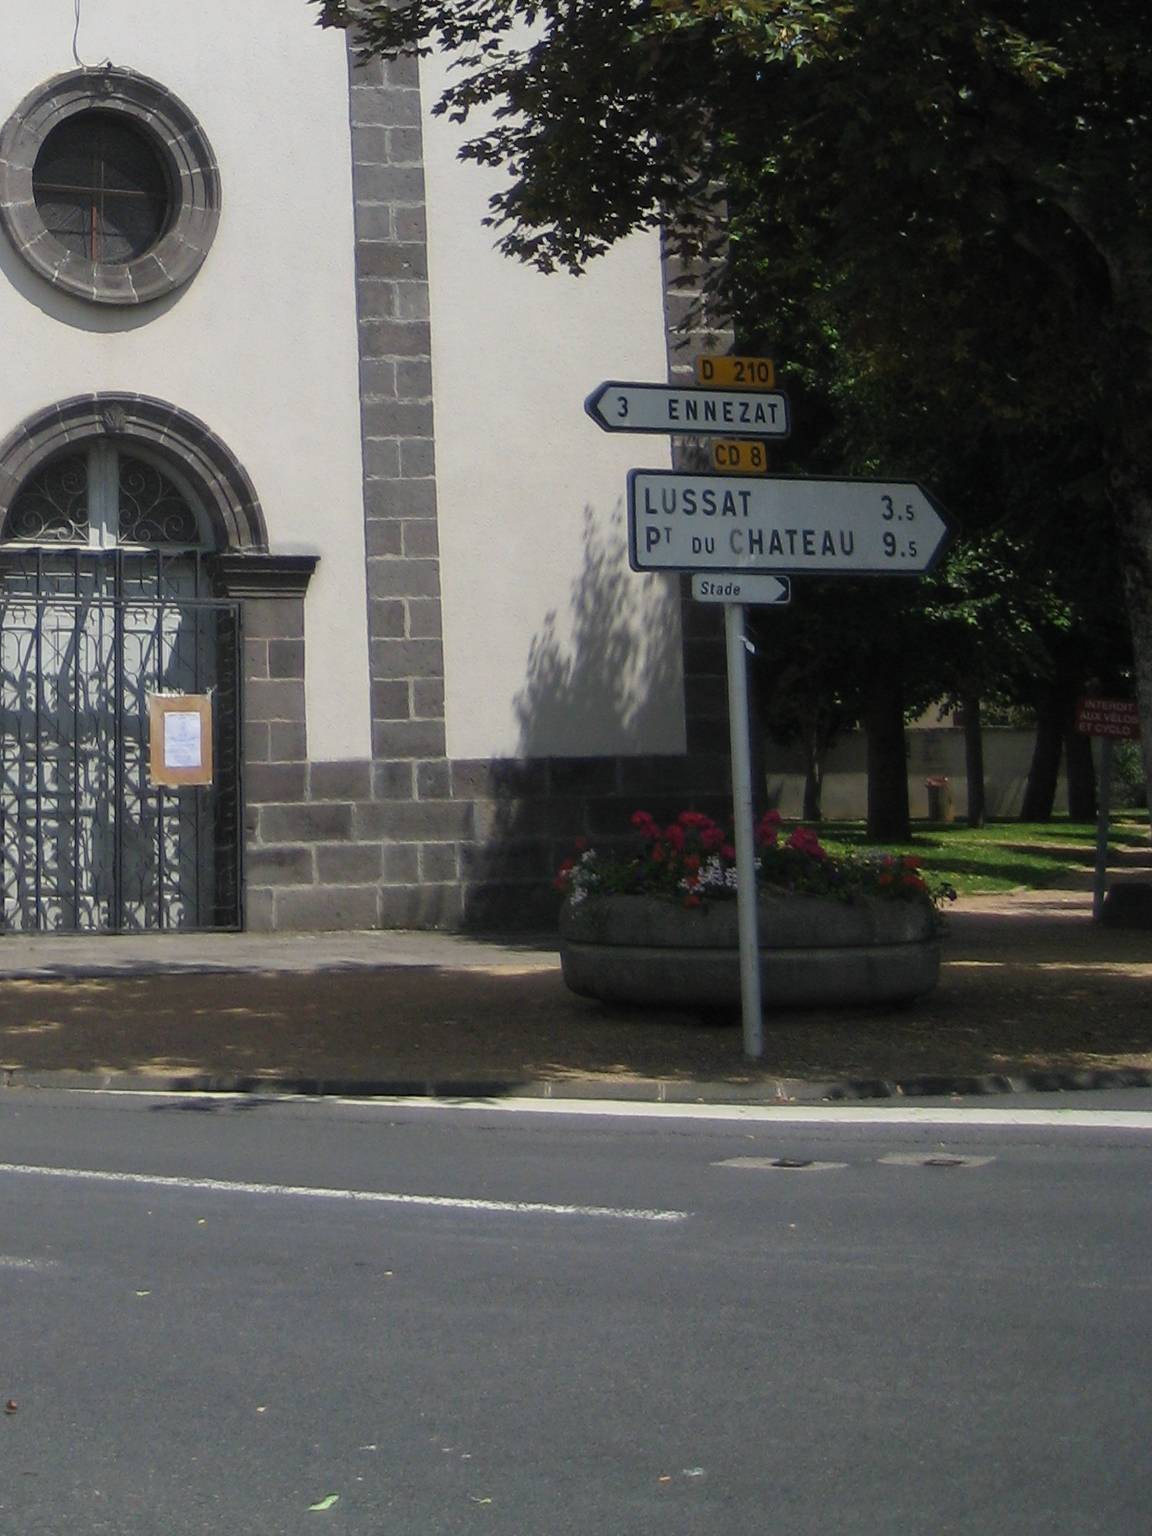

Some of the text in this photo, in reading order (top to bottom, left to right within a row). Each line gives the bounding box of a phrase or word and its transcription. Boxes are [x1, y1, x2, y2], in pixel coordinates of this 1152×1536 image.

[701, 359, 770, 383] D 210
[616, 396, 778, 424] 3 ENNEZAT
[714, 443, 762, 468] CD 8
[644, 487, 915, 521] LUSSAT 3.5
[691, 536, 715, 555] DU
[729, 528, 855, 557] CHATEAU
[882, 531, 918, 558] 9.5
[700, 580, 741, 597] Stade
[1079, 710, 1101, 721] AUX
[1079, 721, 1092, 732] ET
